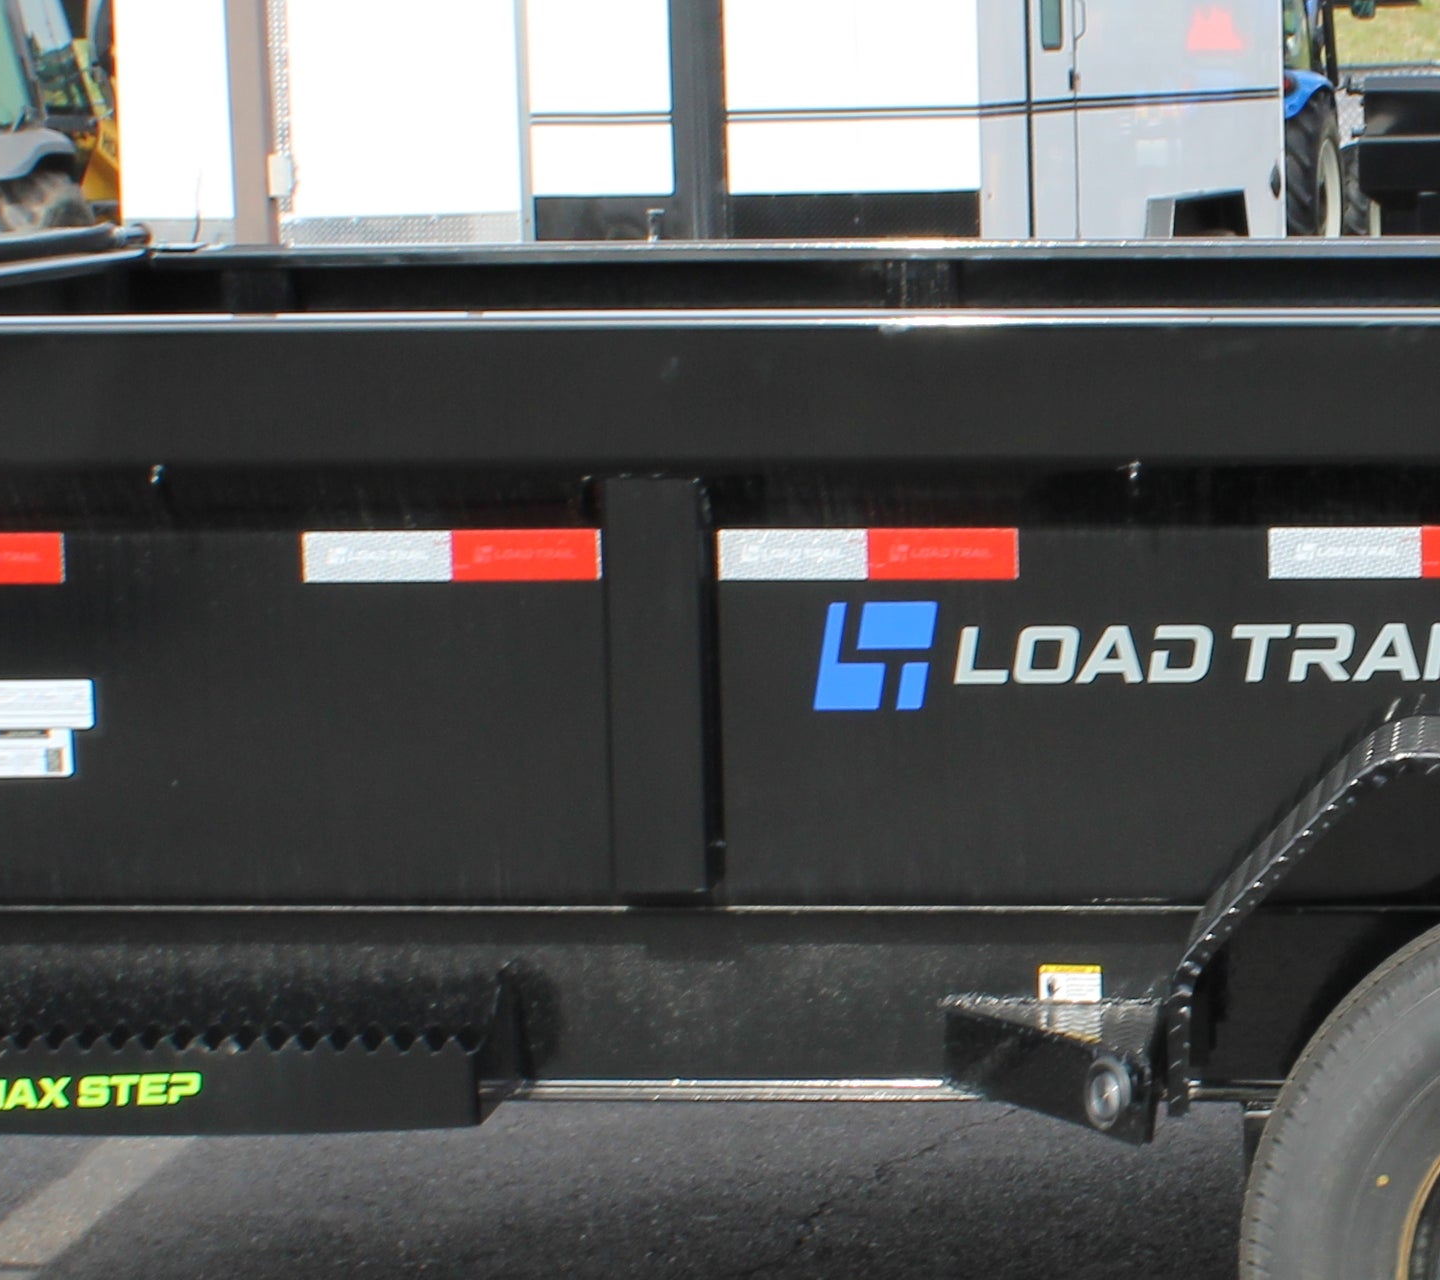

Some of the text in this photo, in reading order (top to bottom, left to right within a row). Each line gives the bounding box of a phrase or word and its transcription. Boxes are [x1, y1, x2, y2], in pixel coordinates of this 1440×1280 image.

[2, 552, 41, 563] TRAIL
[347, 549, 431, 561] LOAD TRAIL
[492, 547, 576, 560] LOAD TRAIL
[760, 548, 845, 560] LOAD TRAIL
[910, 547, 992, 558] LOAD TRAIL
[1316, 546, 1400, 557] LOAD TRAIL
[953, 624, 1213, 684] LOAD
[77, 1072, 202, 1108] STEP
